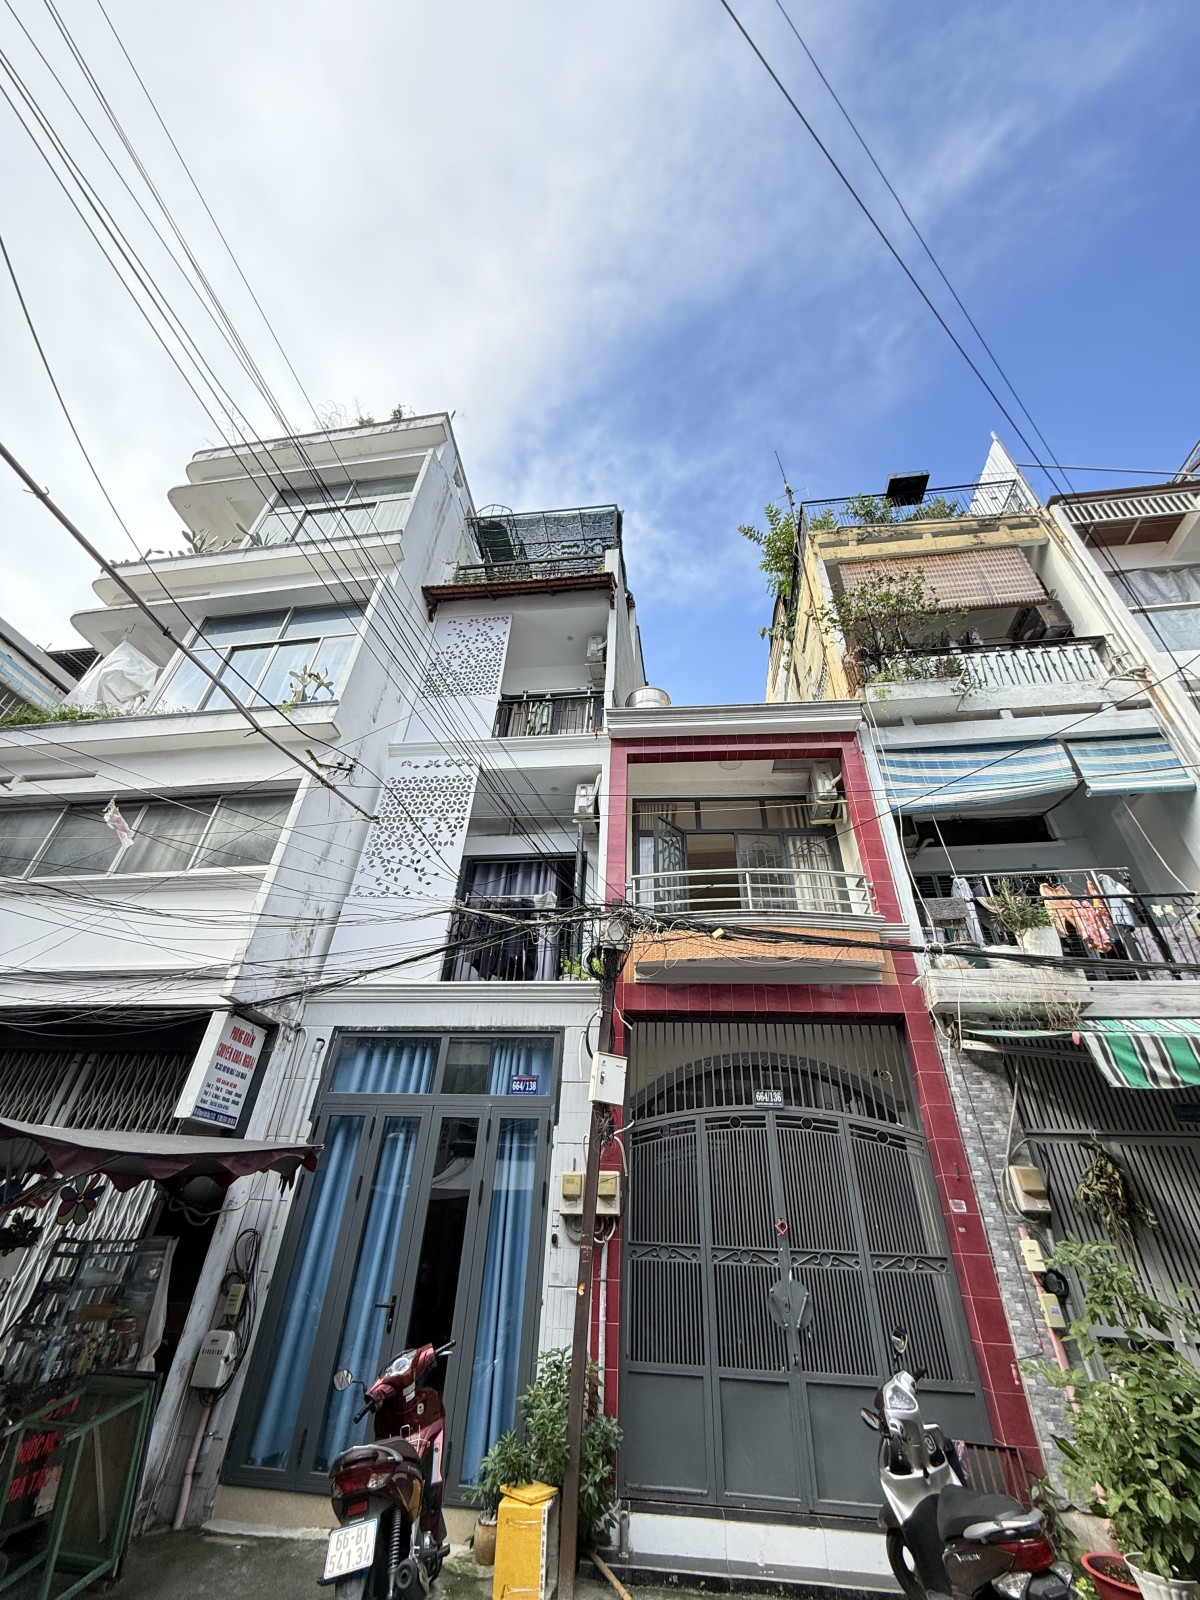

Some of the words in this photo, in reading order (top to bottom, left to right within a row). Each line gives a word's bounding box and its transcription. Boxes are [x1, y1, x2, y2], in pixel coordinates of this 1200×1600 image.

[512, 1081, 536, 1091] 664/138
[756, 1091, 782, 1102] 664/136
[328, 1544, 371, 1574] 541.34
